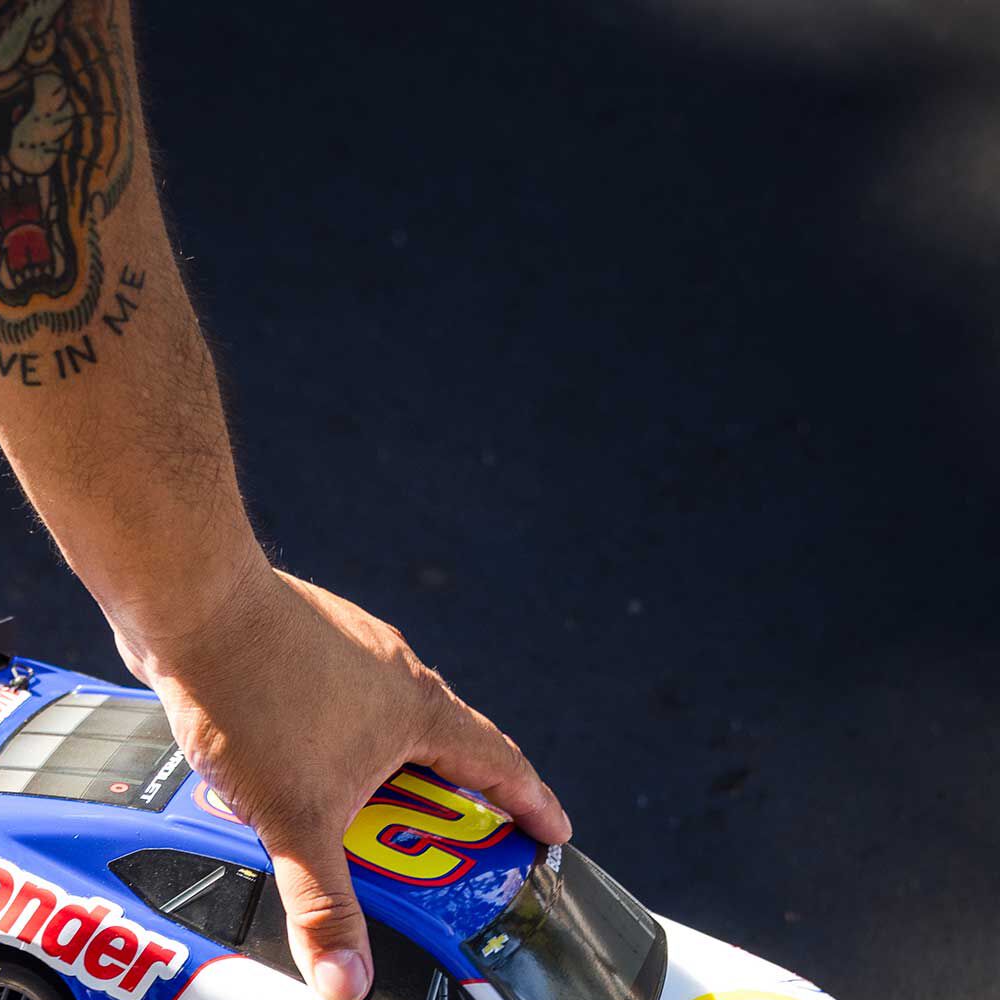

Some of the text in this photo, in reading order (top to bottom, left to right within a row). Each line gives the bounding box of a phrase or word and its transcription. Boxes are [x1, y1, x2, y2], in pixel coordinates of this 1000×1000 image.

[55, 335, 97, 379] IN
[103, 263, 145, 336] ME
[338, 763, 516, 888] 2
